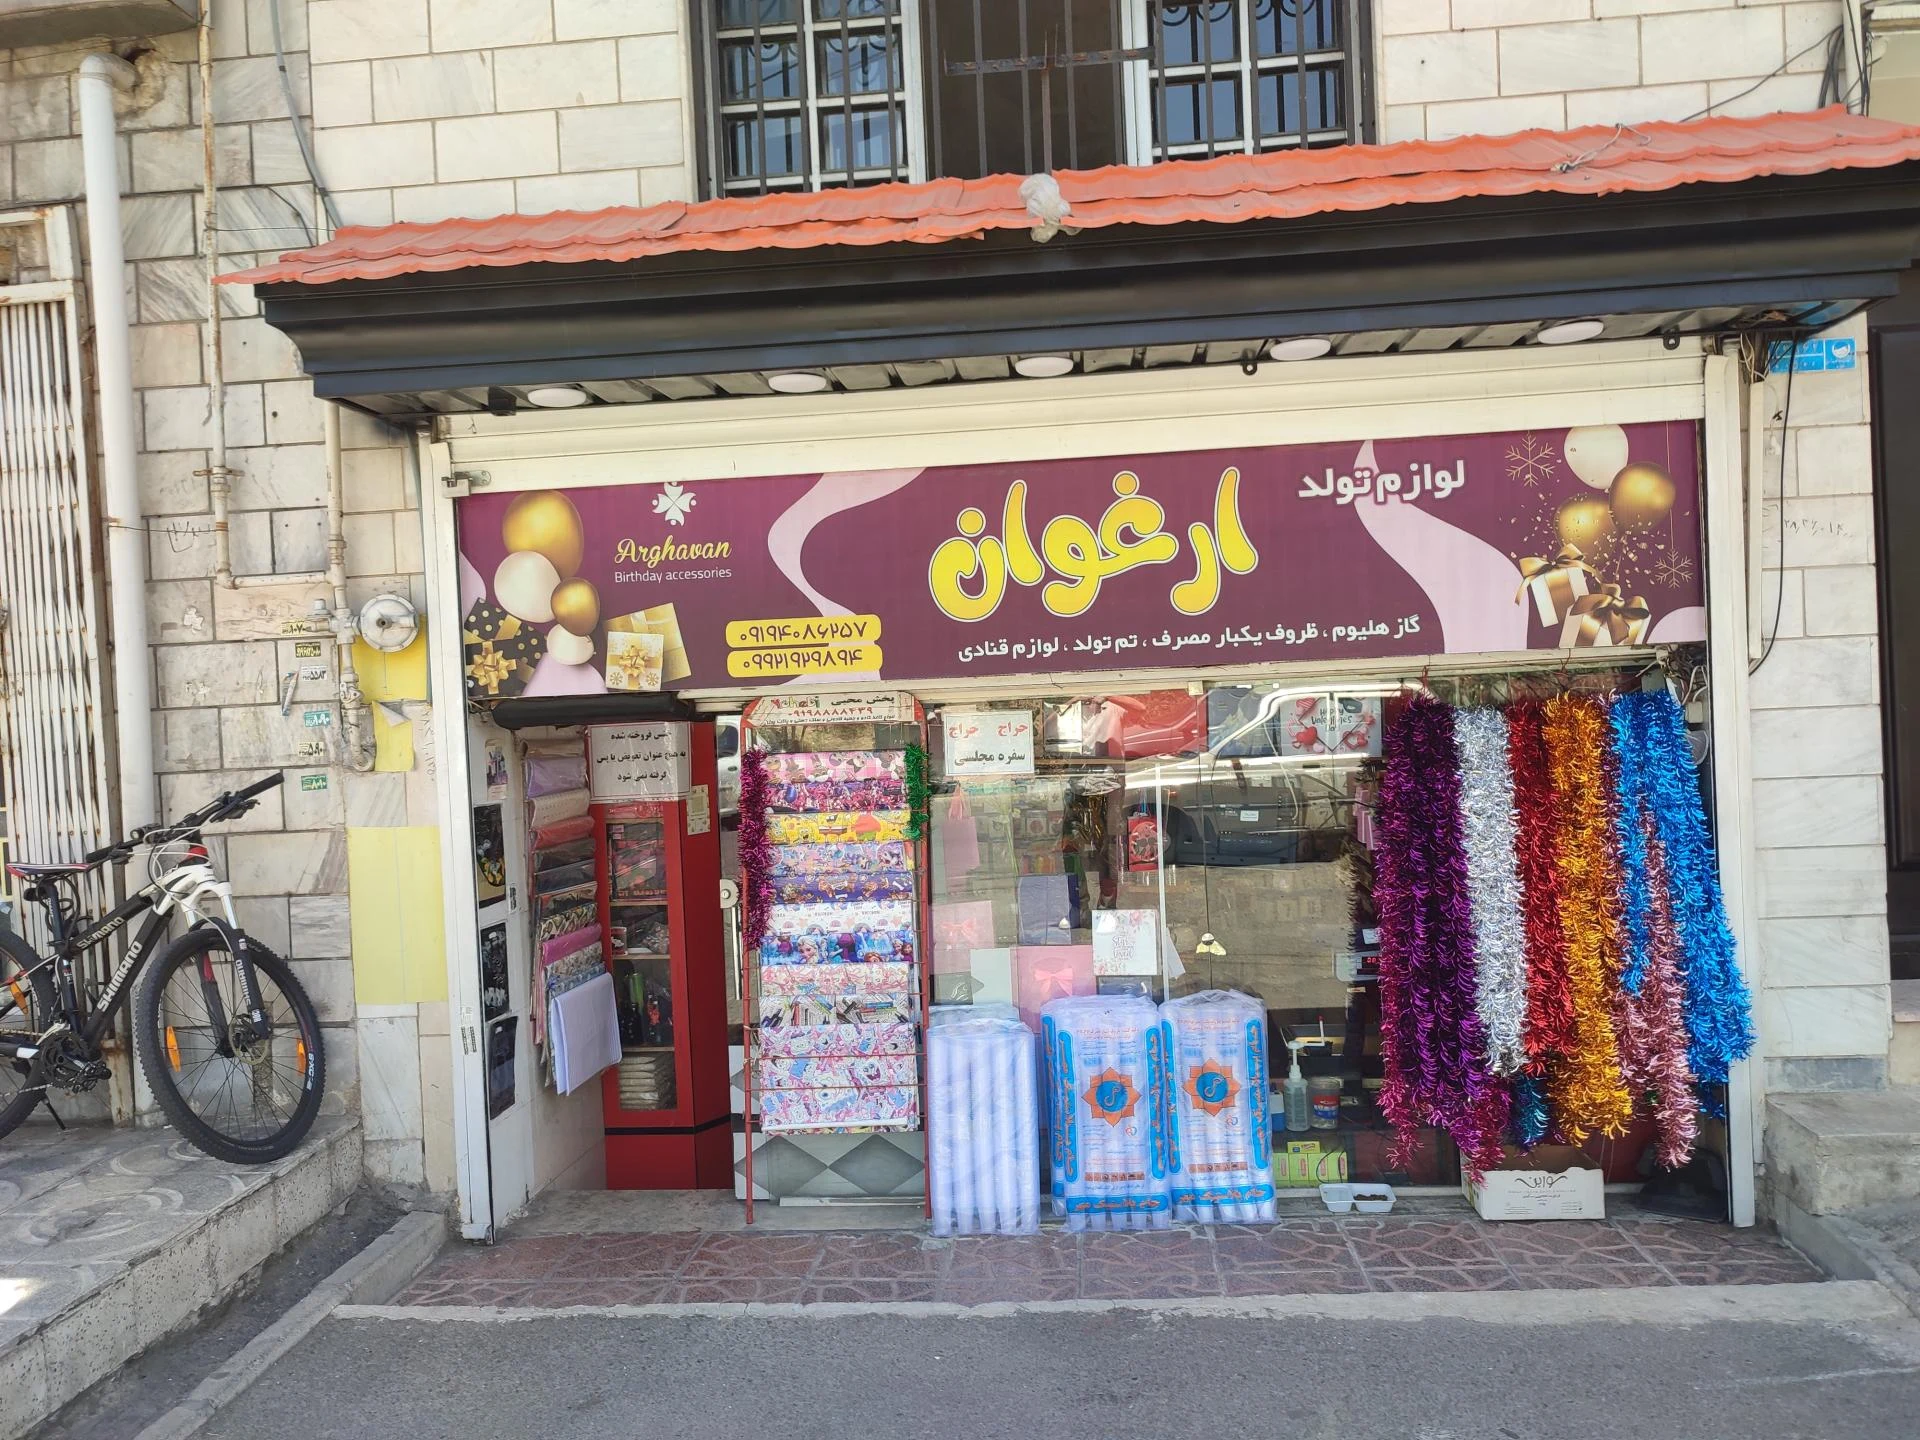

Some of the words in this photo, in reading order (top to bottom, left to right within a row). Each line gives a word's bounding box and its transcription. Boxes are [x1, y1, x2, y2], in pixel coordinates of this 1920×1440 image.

[1298, 468, 1372, 505] تولد
[1376, 459, 1465, 502] لوازم
[614, 534, 733, 569] Arghavan
[928, 466, 1259, 622] ارغوان
[614, 571, 662, 584] Birthday
[665, 567, 733, 581] accessories
[740, 621, 868, 643] ۰۹۱۹۴۰۸۶۲۵۷
[1215, 625, 1263, 648] یکبار
[1265, 622, 1318, 645] ظروف
[1332, 620, 1390, 642] هلیوم
[1394, 614, 1421, 639] گاز
[958, 639, 1009, 662] قنادی
[1012, 637, 1059, 659] لوازم
[1073, 635, 1112, 655] تولد
[1114, 634, 1138, 653] تم
[1152, 629, 1211, 652] مصرف
[743, 648, 863, 670] ۰۹۹۲۱۹۲۹۸۹۴
[866, 695, 896, 707] پخش
[610, 731, 625, 740] شده
[949, 722, 979, 739] حراج
[997, 721, 1029, 737] حراج
[617, 752, 642, 762] تعویض
[643, 752, 663, 761] عنوان
[954, 750, 995, 766] مجلسی
[998, 748, 1026, 765] سفره
[617, 772, 632, 783] شود
[634, 772, 648, 782] نمی
[649, 771, 667, 781] گرفته
[97, 940, 143, 1012] SHIMANO
